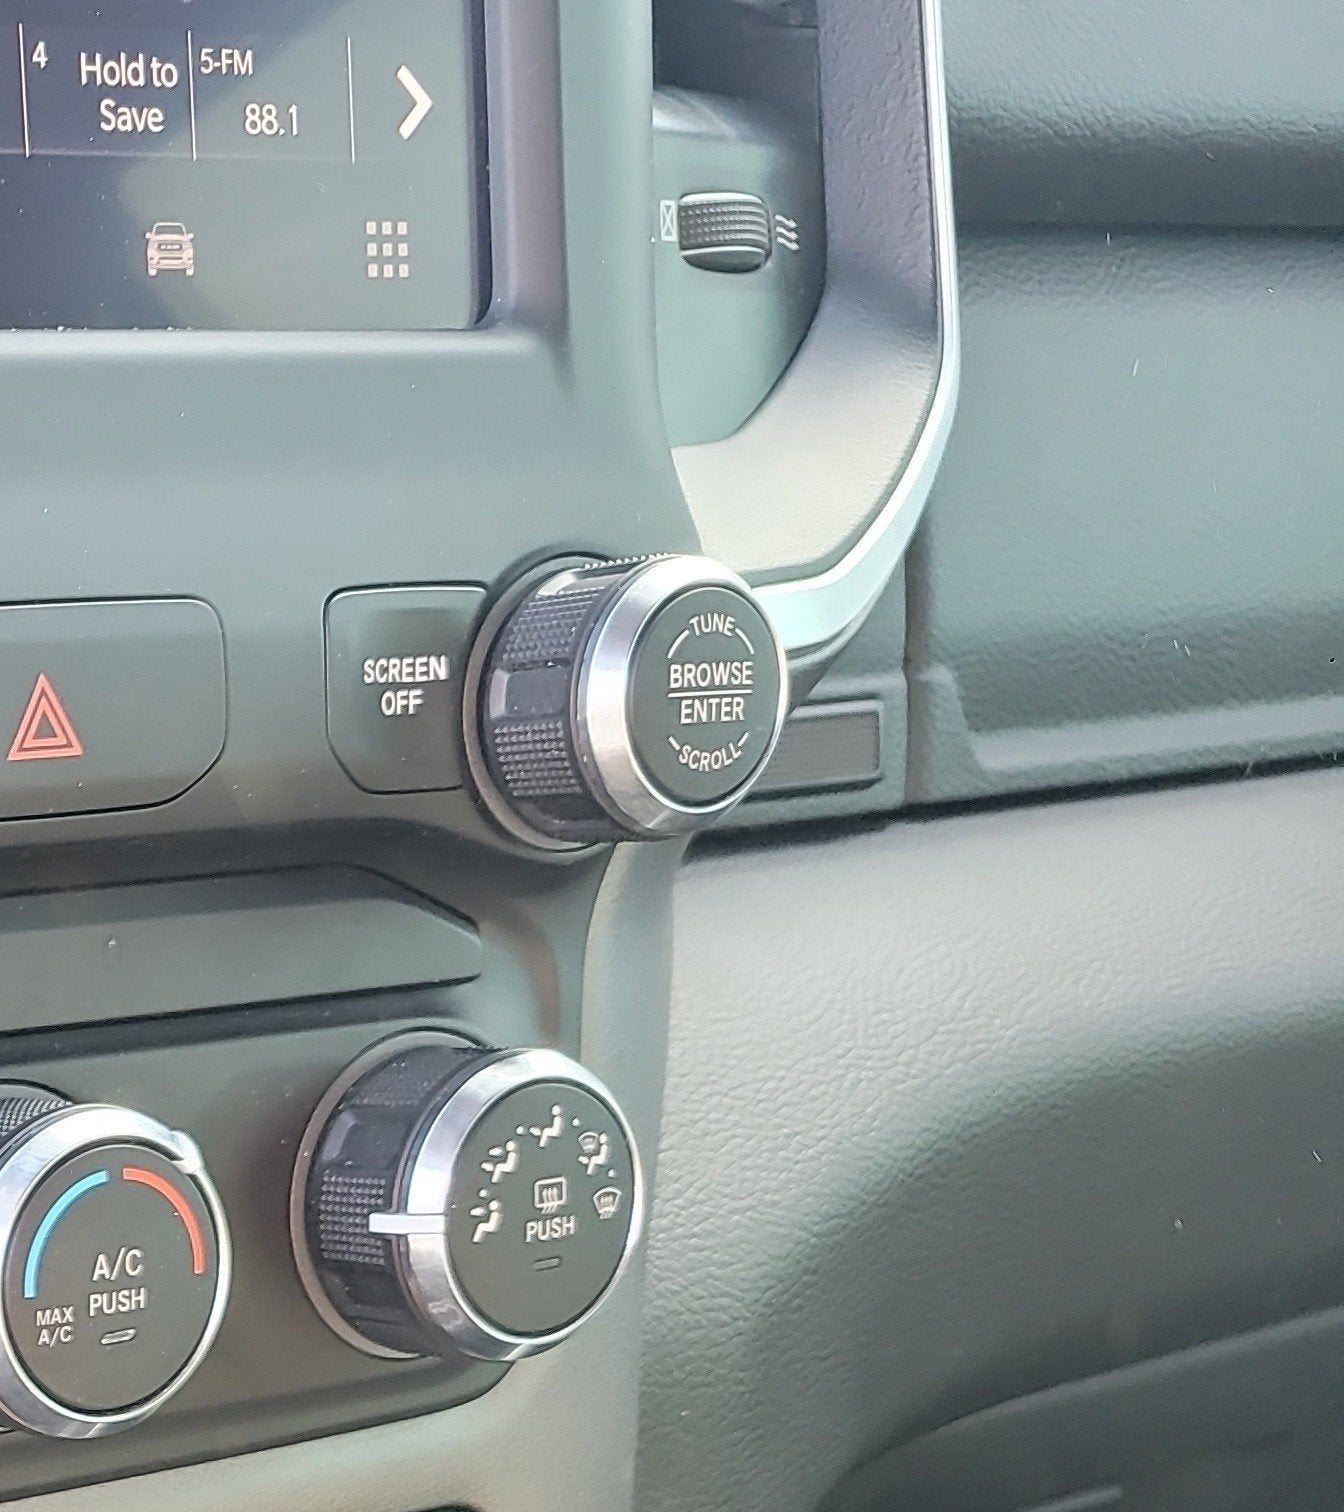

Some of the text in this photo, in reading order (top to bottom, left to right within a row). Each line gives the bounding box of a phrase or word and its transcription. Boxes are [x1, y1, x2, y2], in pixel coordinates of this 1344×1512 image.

[32, 42, 48, 69] 4
[199, 47, 253, 76] 5-FM
[79, 52, 178, 88] Hold to
[99, 99, 165, 133] Save
[244, 103, 300, 137] 88.1
[689, 613, 736, 638] TUNE
[363, 656, 448, 684] SCREEN
[668, 662, 754, 689] BROWSE
[381, 688, 424, 717] OFF
[679, 698, 745, 725] ENTER
[678, 744, 743, 772] SCROLL
[524, 1214, 577, 1244] PUSH
[92, 1247, 143, 1283] A/C
[88, 1288, 146, 1317] PUSH
[35, 1307, 75, 1328] MAX
[37, 1324, 74, 1347] A/C
